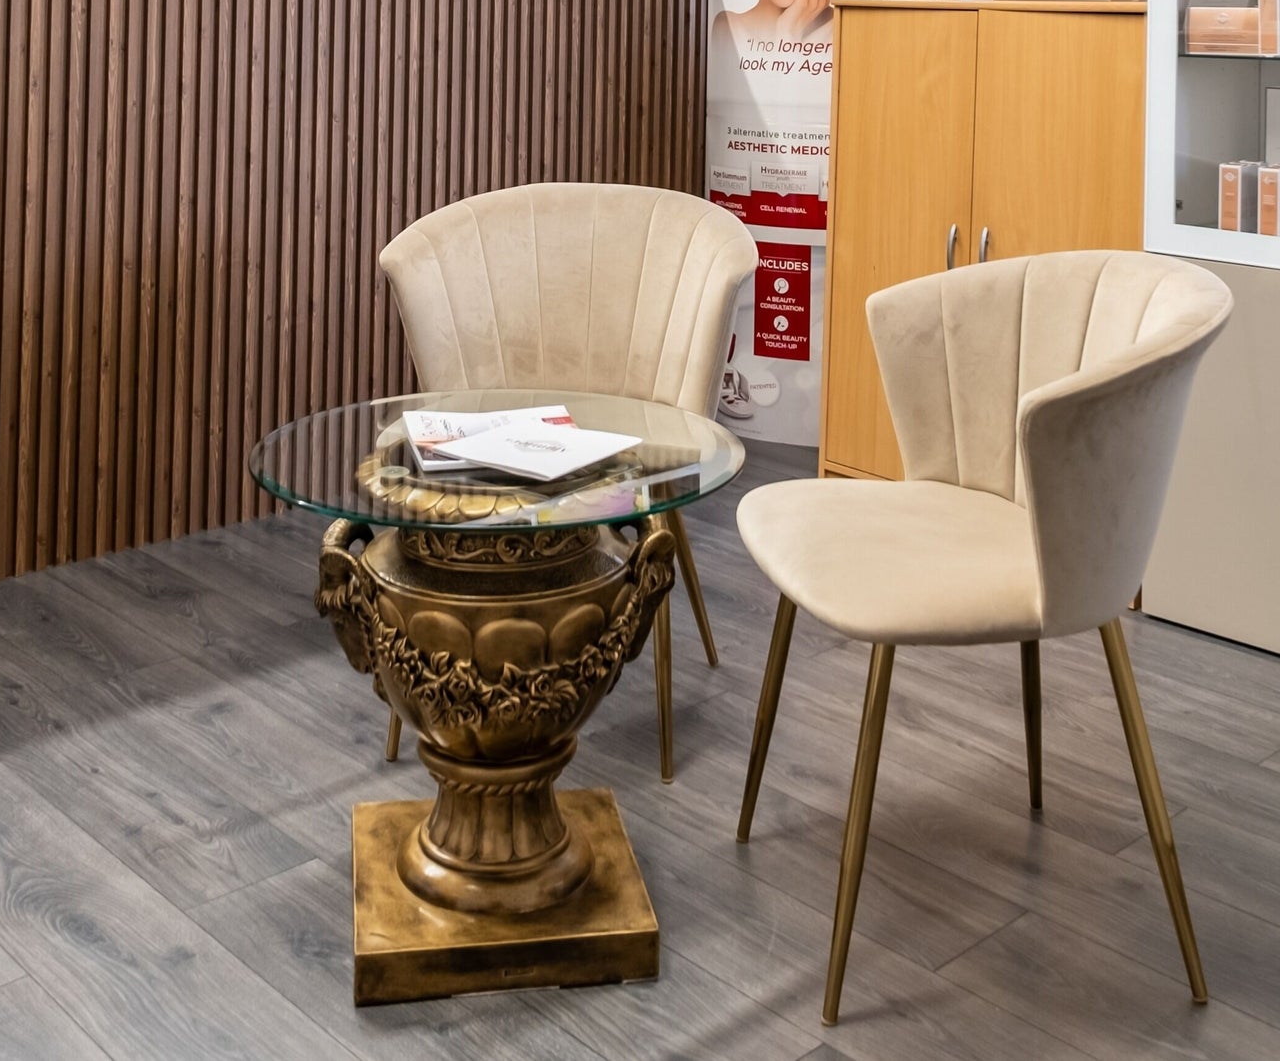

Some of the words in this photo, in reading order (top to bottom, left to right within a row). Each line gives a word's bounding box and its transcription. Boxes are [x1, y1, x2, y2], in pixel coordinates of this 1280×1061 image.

[757, 41, 774, 52] no
[778, 39, 832, 56] longer
[739, 58, 767, 71] look
[771, 60, 794, 75] my
[799, 58, 833, 75] Age
[733, 127, 779, 138] alternative
[727, 141, 787, 154] AESTHETIC
[713, 170, 722, 179] Age
[761, 181, 807, 191] TREATMENT
[776, 206, 807, 214] RENEWAL
[759, 259, 809, 271] NCLUDES
[760, 303, 805, 312] CONSULTATION
[762, 332, 781, 340] QUICK
[782, 333, 807, 342] BEAUTY
[765, 341, 798, 349] TOUCH-UP
